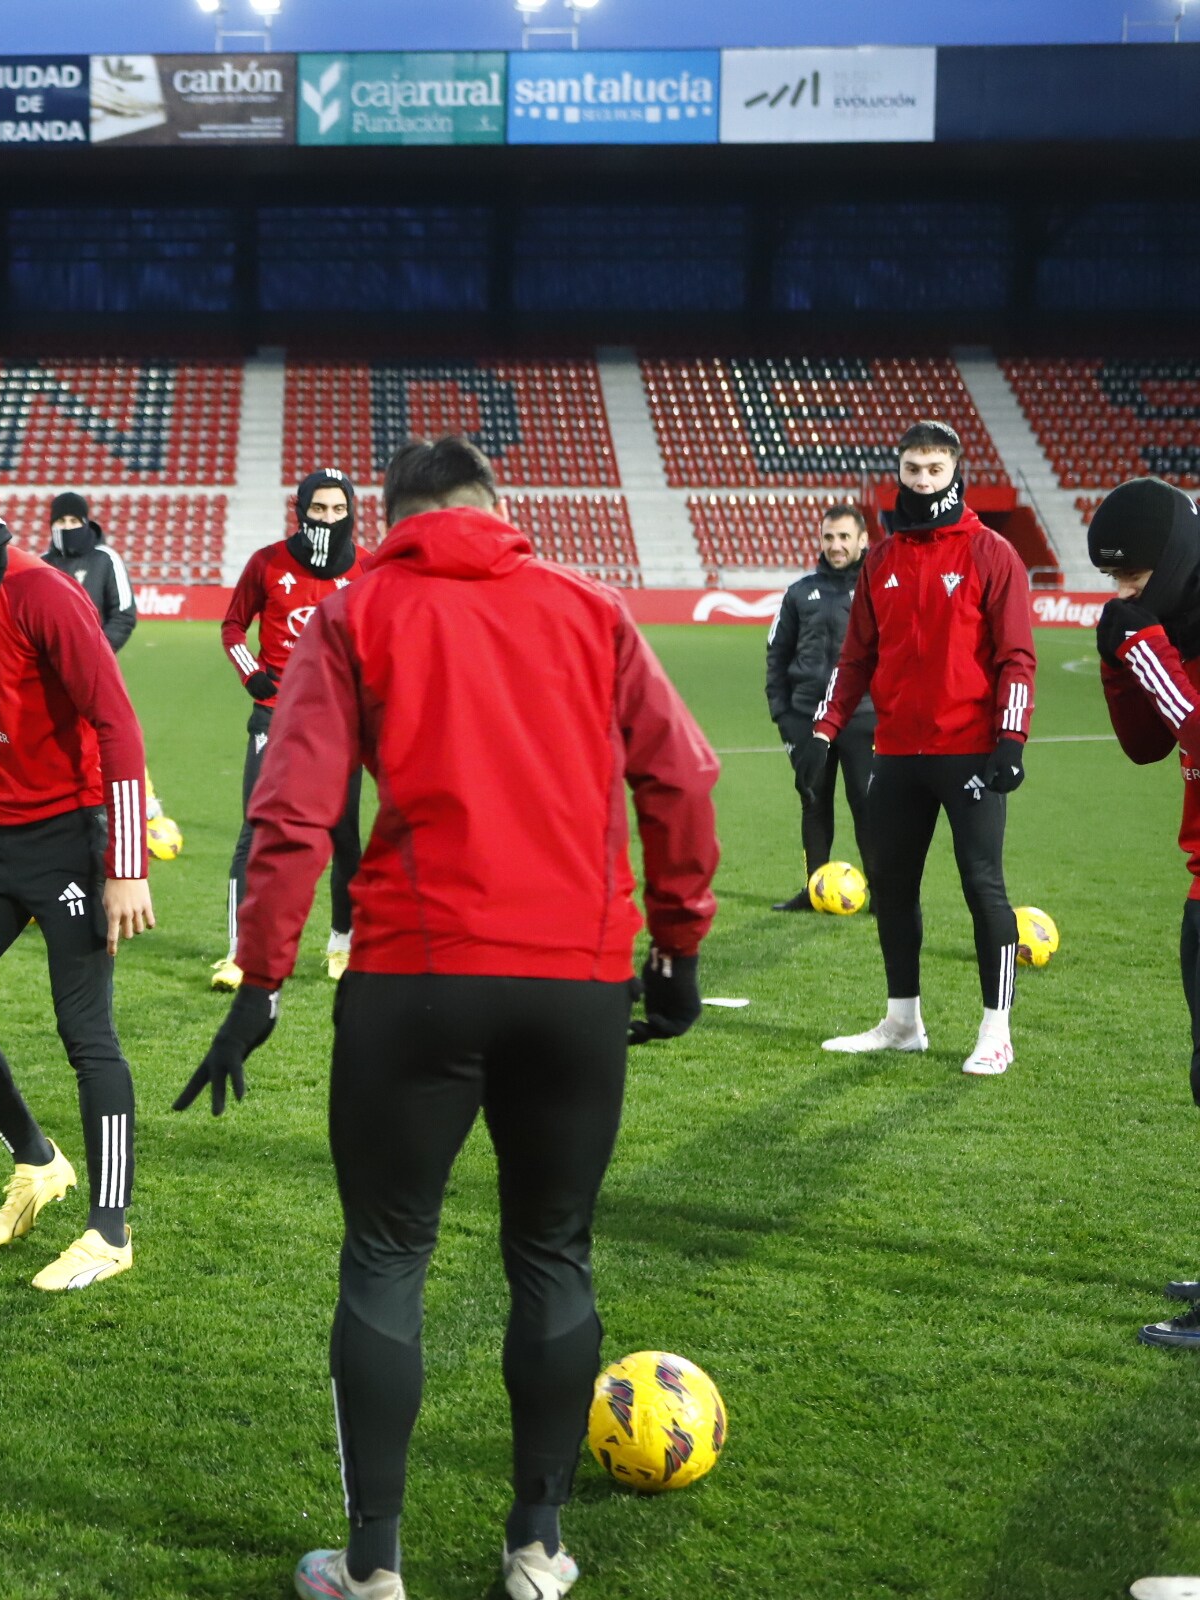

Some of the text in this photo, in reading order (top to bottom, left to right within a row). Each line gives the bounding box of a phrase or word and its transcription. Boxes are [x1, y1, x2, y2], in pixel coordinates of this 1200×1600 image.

[173, 62, 283, 94] carbón
[15, 95, 44, 114] DE
[973, 787, 982, 801] 4
[66, 899, 85, 917] 11
